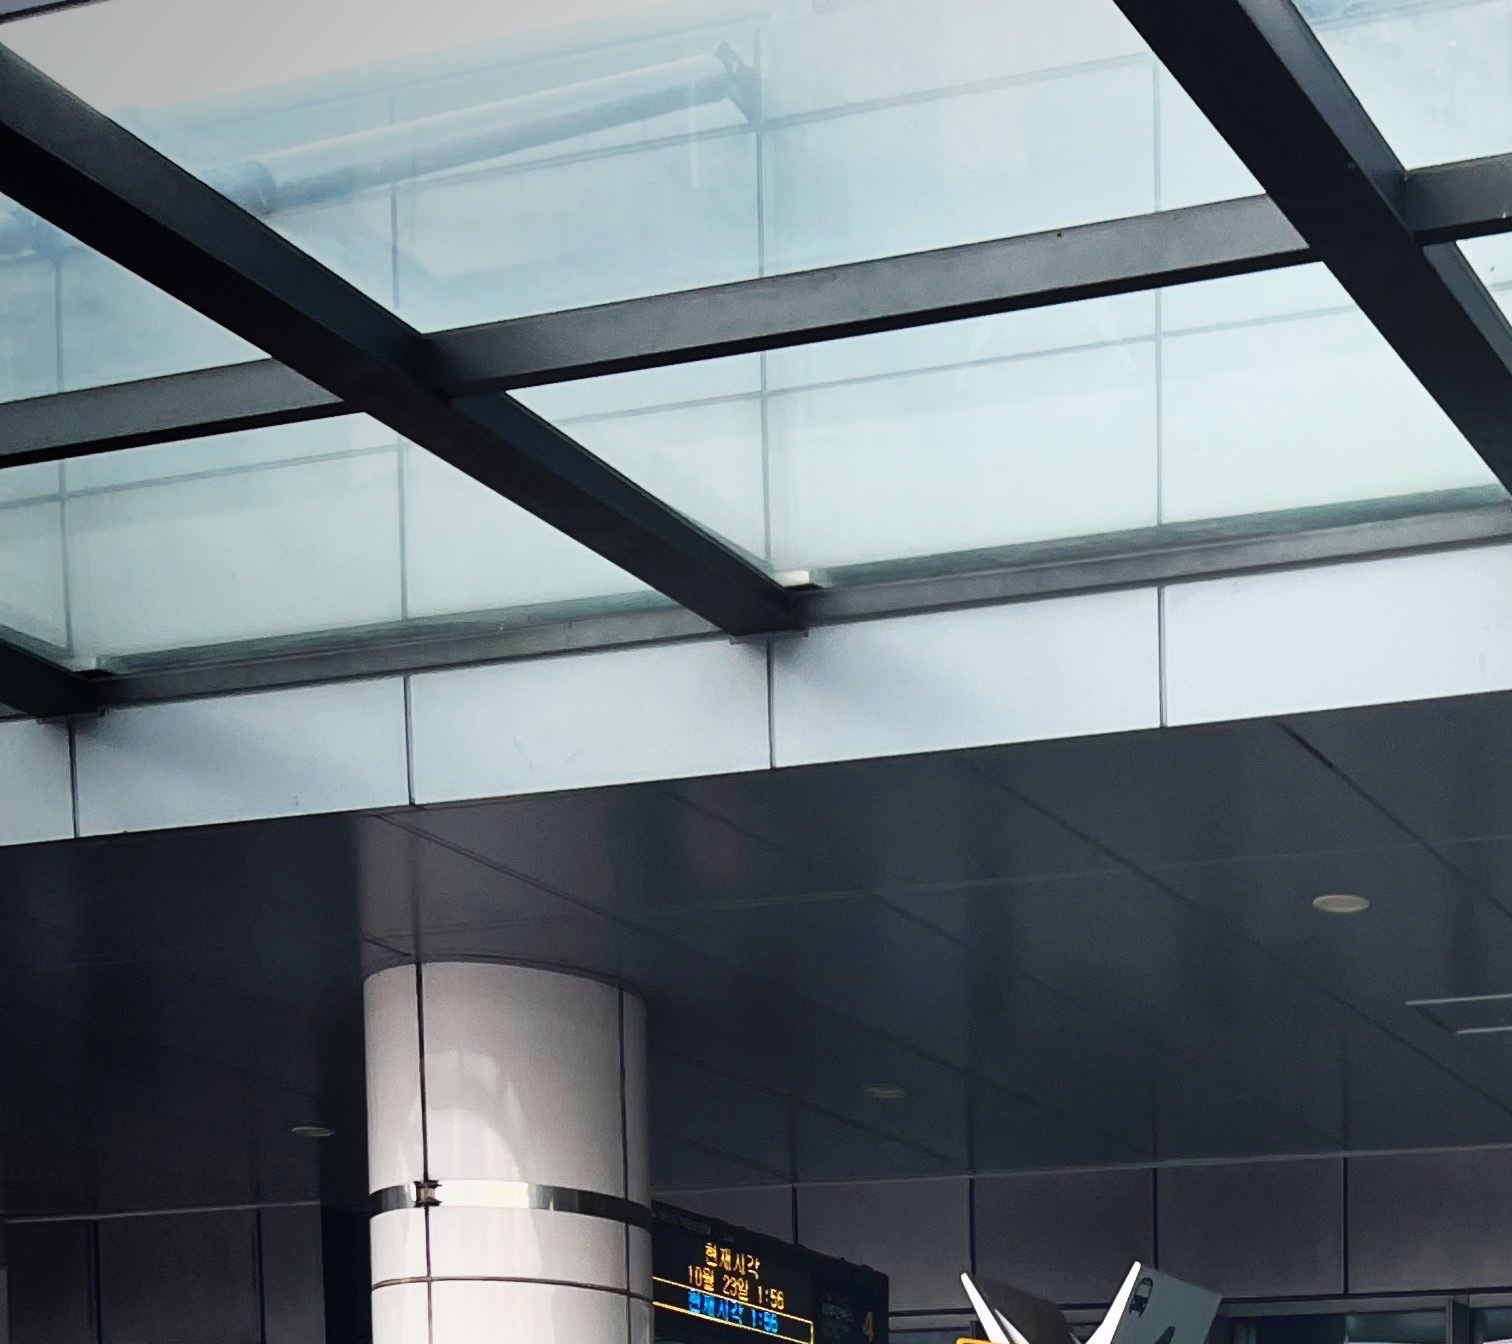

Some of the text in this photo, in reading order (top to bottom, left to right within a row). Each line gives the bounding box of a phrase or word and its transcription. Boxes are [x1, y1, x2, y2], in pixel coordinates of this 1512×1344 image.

[704, 1242, 761, 1280] 현재시각
[687, 1264, 715, 1292] 10월
[722, 1274, 749, 1302] 23일
